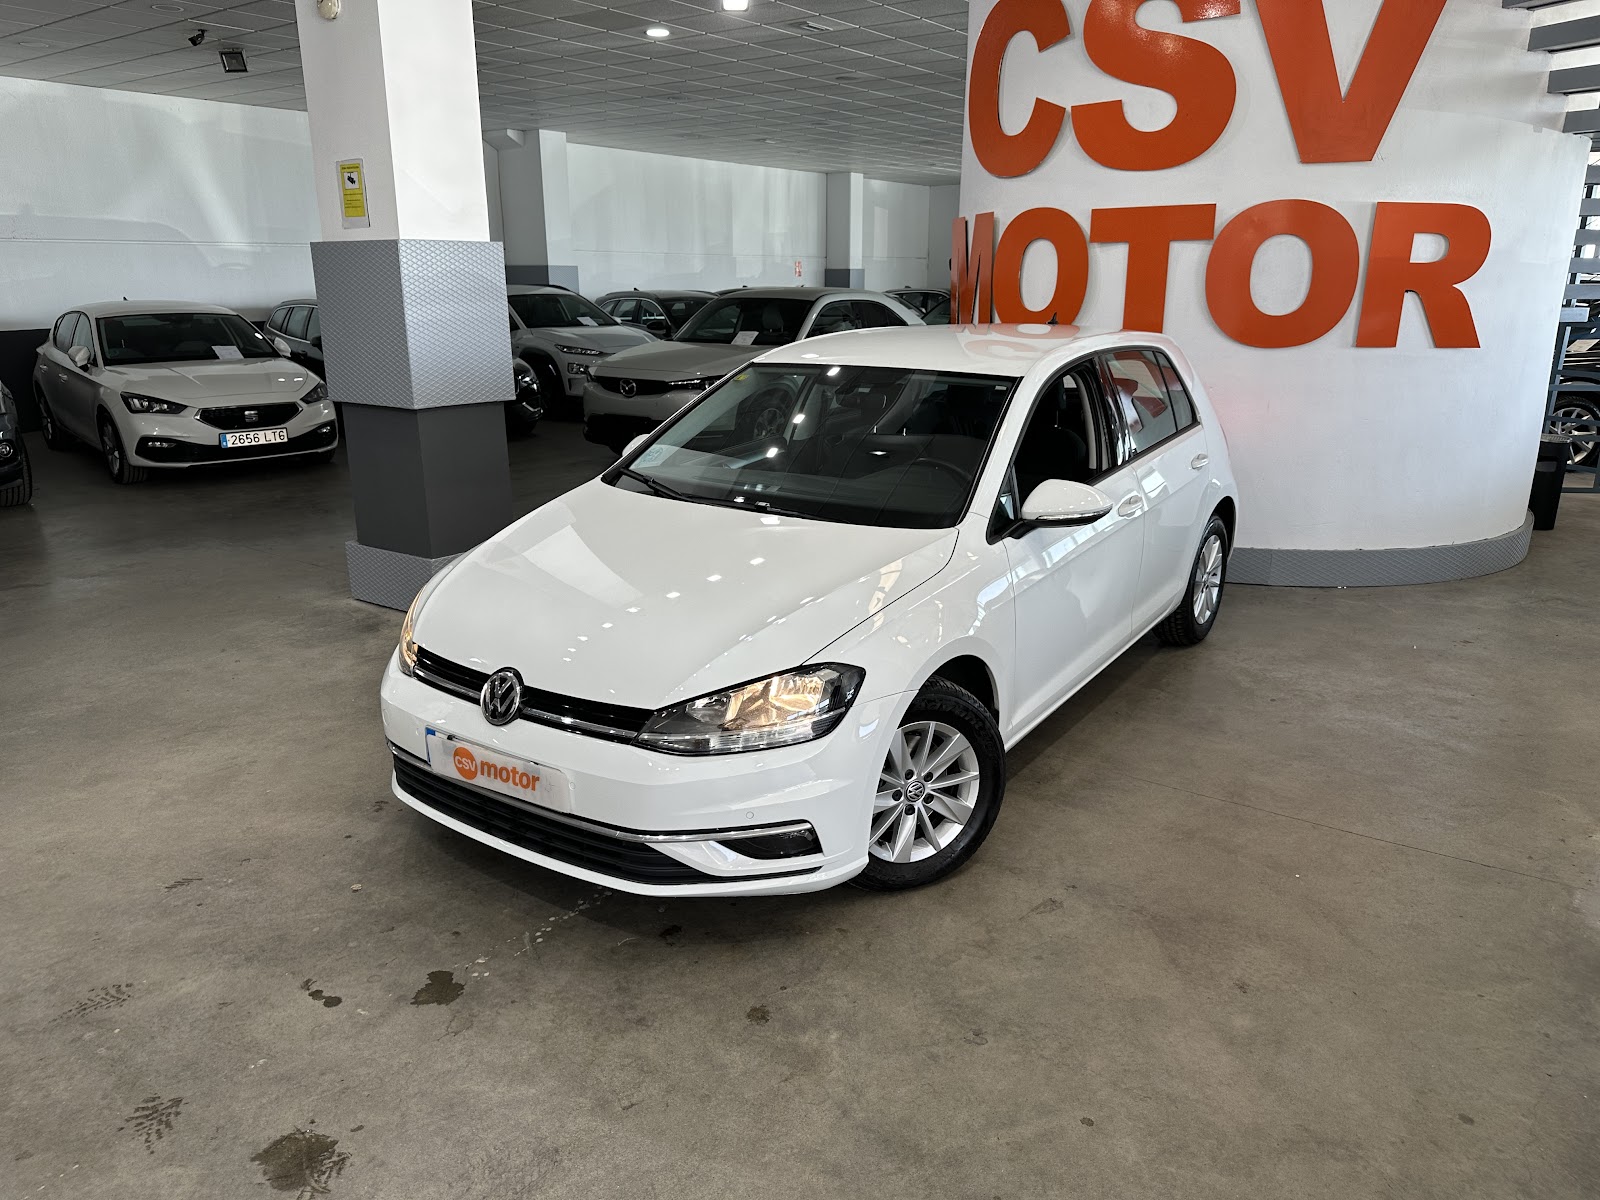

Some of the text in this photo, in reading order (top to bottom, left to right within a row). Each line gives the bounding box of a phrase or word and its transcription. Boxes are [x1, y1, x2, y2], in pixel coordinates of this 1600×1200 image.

[968, 0, 1447, 178] CSV
[951, 199, 1492, 348] MOTOR
[231, 432, 260, 446] 2656
[455, 755, 540, 792] CSV motor
